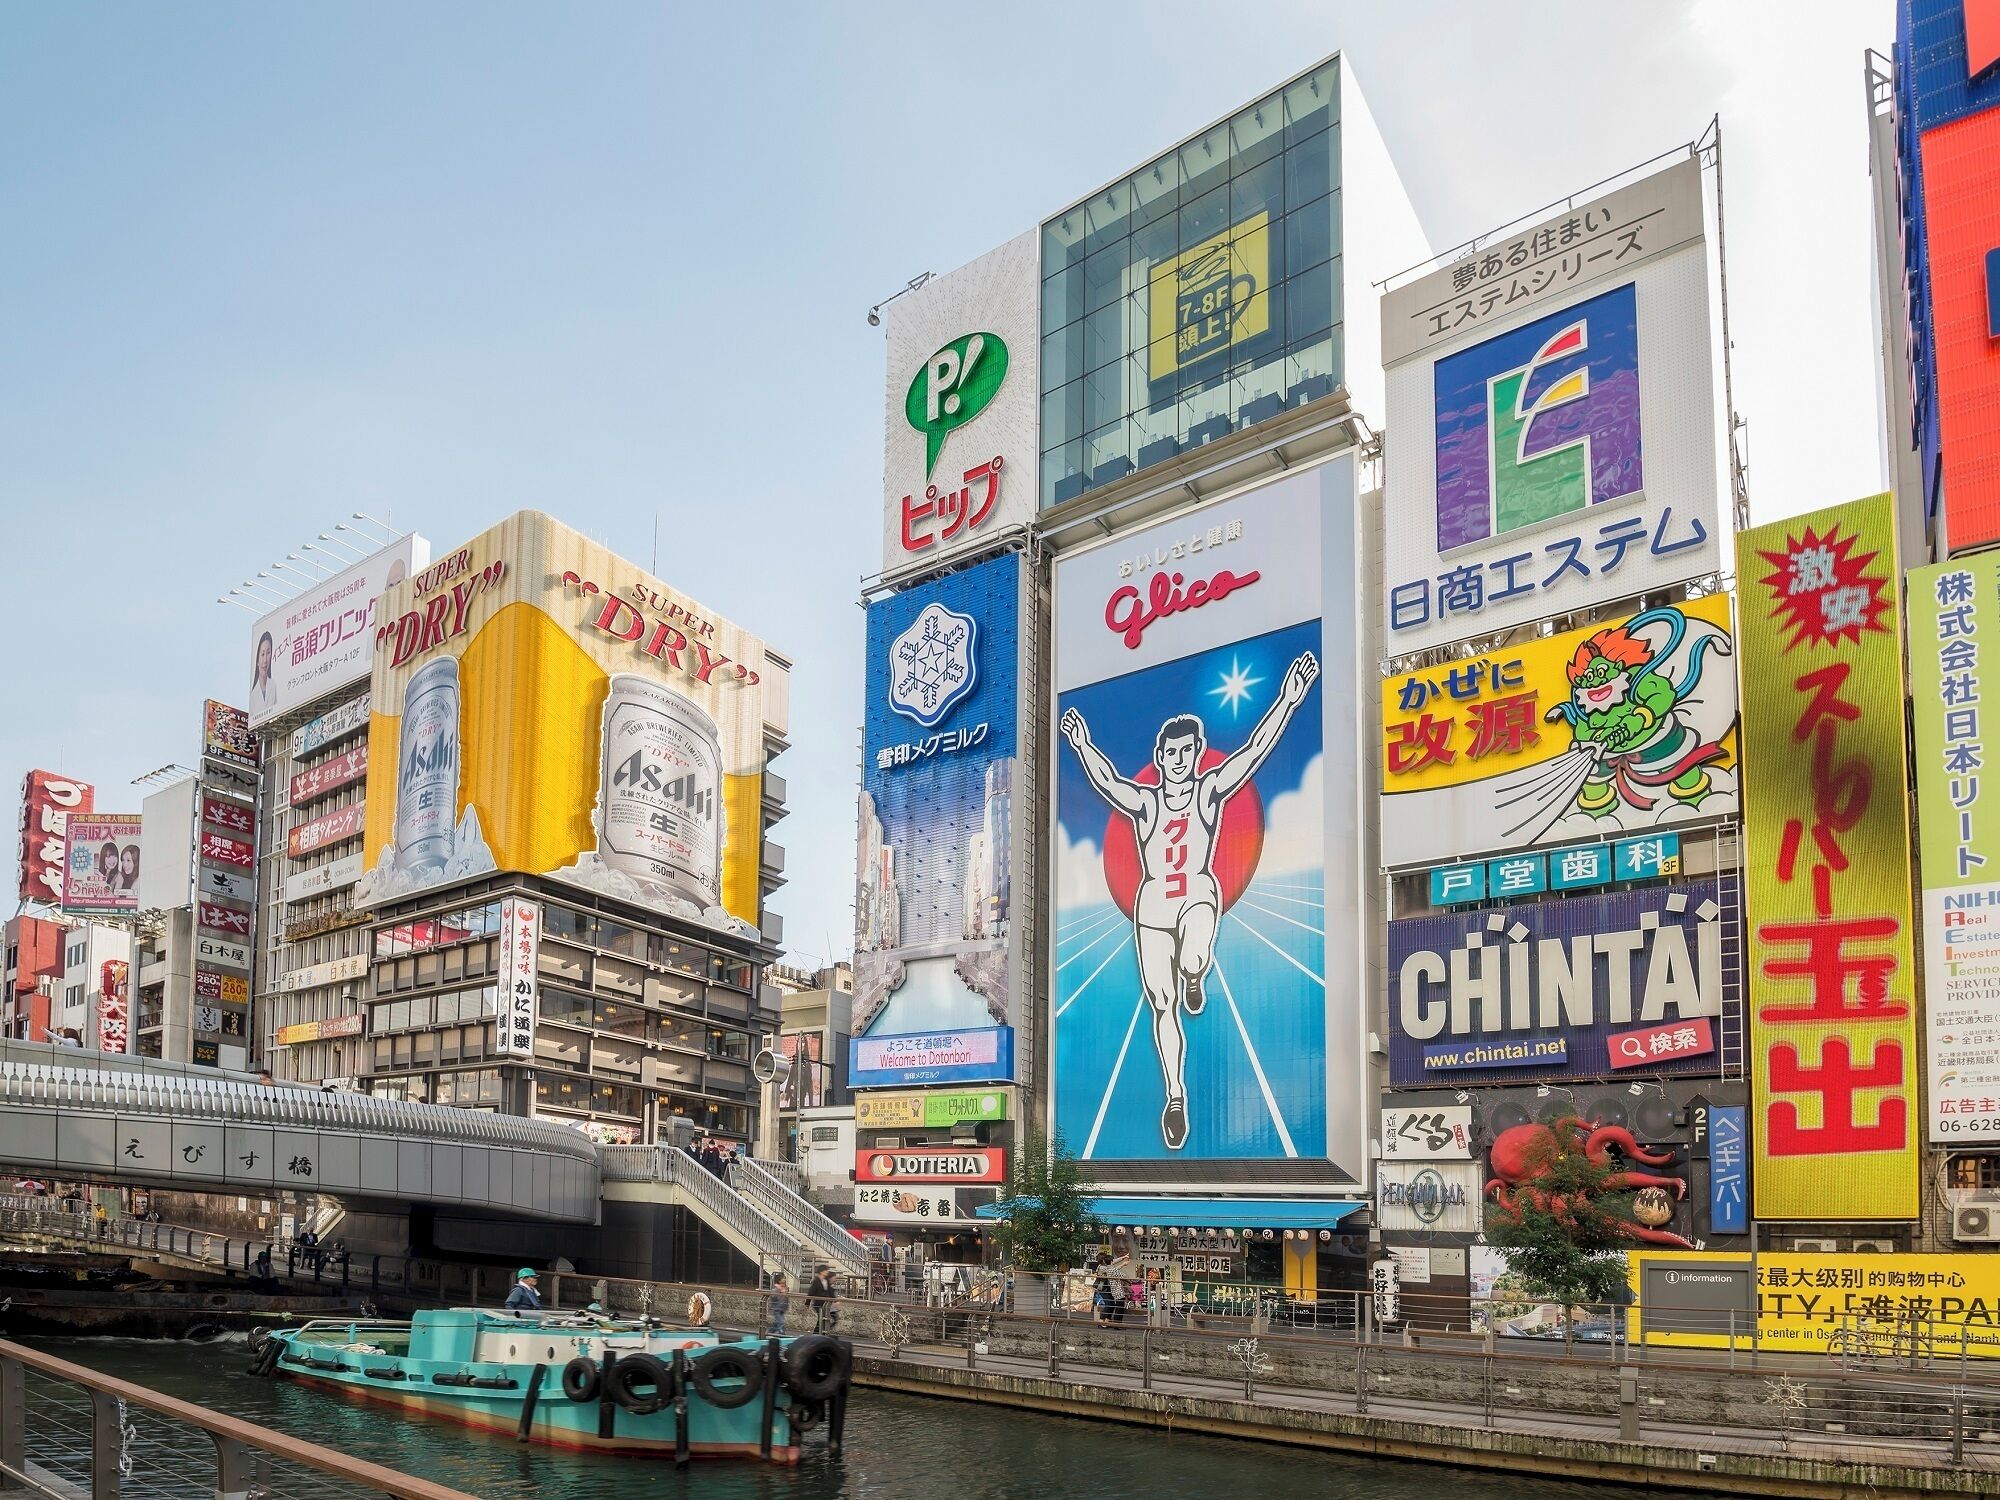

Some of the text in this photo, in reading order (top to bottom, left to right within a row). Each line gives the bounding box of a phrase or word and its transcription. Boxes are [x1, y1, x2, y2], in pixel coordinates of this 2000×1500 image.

[1452, 205, 1611, 292] 夢ある住まい
[1429, 227, 1643, 338] エステムシリーズ
[1180, 284, 1230, 326] 7-8F
[900, 454, 1004, 553] ピップ
[1117, 518, 1243, 578] おいしさと健康
[413, 548, 469, 599] SUPER
[1390, 507, 1708, 632] 日商エステム
[1788, 544, 1870, 635] 激安
[631, 583, 715, 640] SUPER
[1104, 570, 1261, 649] Glico
[1397, 658, 1525, 713] かぜに
[627, 722, 645, 737] ASAHI
[645, 721, 683, 742] BREWERIES
[1385, 689, 1543, 776] 改源
[1937, 570, 1985, 876] 株式会社日本リート
[293, 734, 304, 754] 9F
[403, 728, 454, 791] Asahi
[876, 722, 989, 770] 雪印メグミルク
[418, 789, 434, 811] 生
[613, 748, 713, 822] Asahi
[300, 809, 355, 852] 相席ダイニング
[649, 811, 679, 838] 生
[202, 844, 253, 865] ダイニング
[210, 835, 232, 850] 相席
[634, 828, 692, 858] スーパードライ
[1162, 811, 1191, 900] グリコ
[650, 862, 675, 880] 350ml
[699, 871, 718, 896] お酒
[1440, 839, 1677, 899] 戸堂歯科 3F
[1944, 890, 2000, 910] NIH
[1944, 911, 1987, 928] Real
[200, 940, 245, 962] 白木屋
[518, 924, 533, 976] 本場の味
[288, 959, 358, 989] 白木屋 白木屋
[512, 978, 533, 1051] かに道楽
[879, 1048, 972, 1068] Welcome to Dotonbori
[886, 1036, 963, 1053] ようこそ道頓堀へ
[1648, 1028, 1698, 1054] 検索
[903, 1071, 940, 1080] 雪印メグミルク
[1939, 1097, 2000, 1114] 広告主
[1397, 1113, 1454, 1152] くくる
[124, 1138, 313, 1178] えびす橋
[897, 1156, 978, 1174] LOTTERIA
[1714, 1116, 1741, 1221] ペンギンバー
[859, 1188, 901, 1204] たこ焼き
[1140, 1236, 1168, 1250] 串カツ
[1681, 1272, 1733, 1283] information
[1868, 1271, 1966, 1288] 的购物中心
[1767, 1327, 1802, 1340] center
[1803, 1327, 1813, 1340] in
